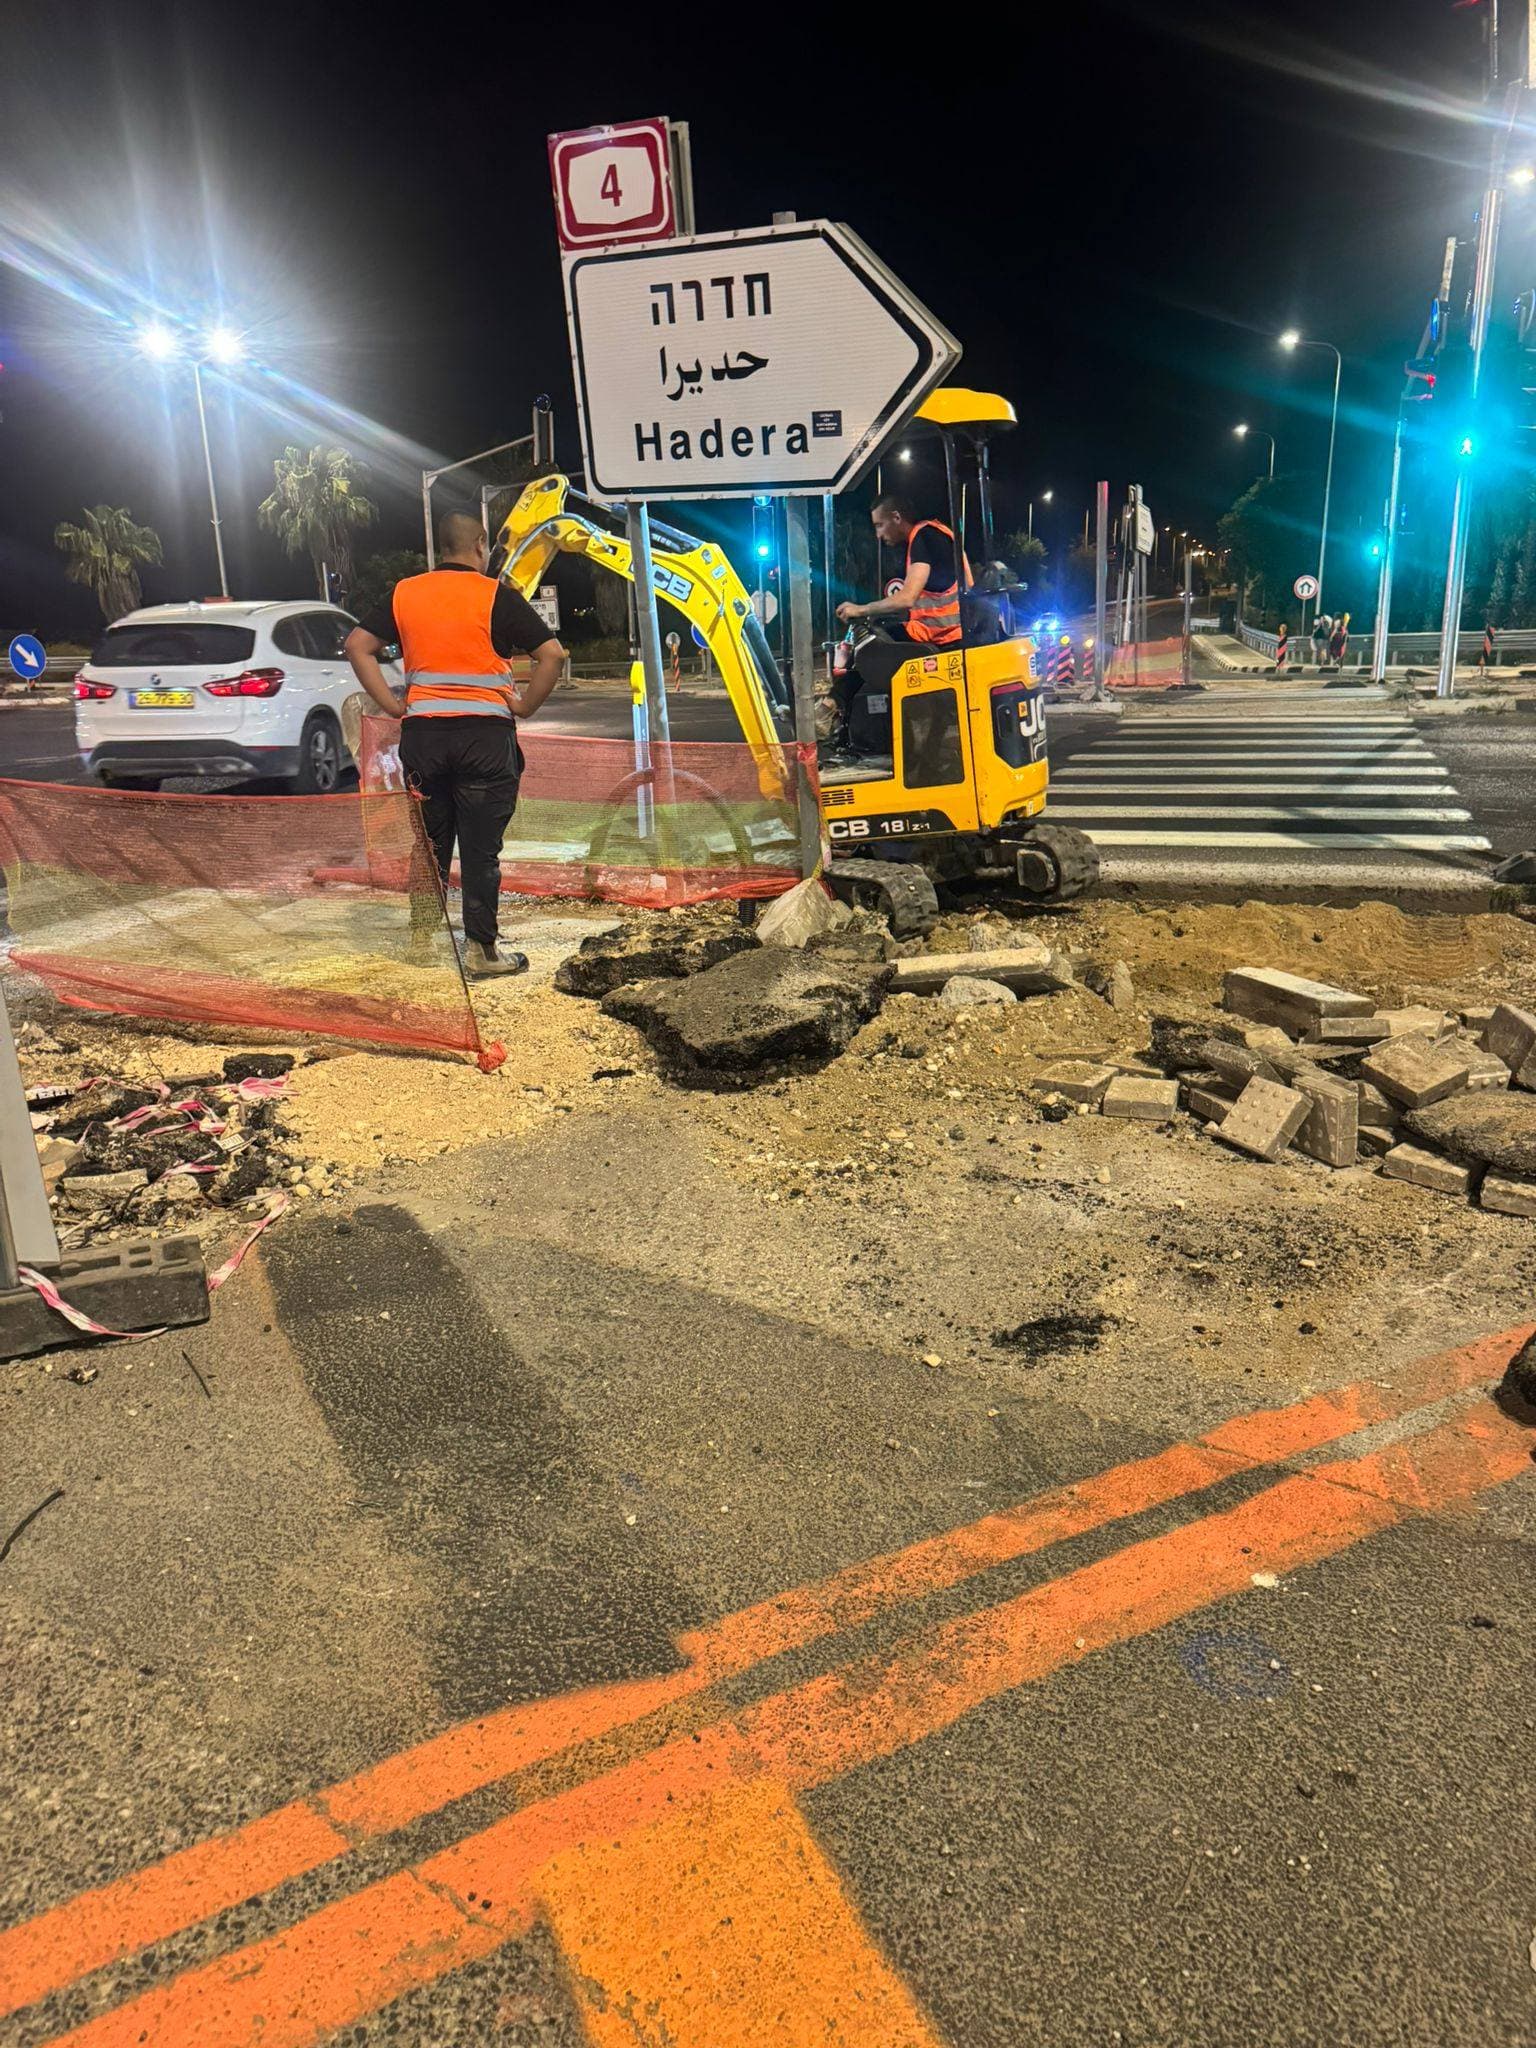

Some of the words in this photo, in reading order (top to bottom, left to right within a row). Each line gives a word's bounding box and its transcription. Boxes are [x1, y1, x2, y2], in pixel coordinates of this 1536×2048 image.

[599, 163, 623, 207] 4
[649, 272, 773, 326] חדרה
[658, 346, 770, 402] حديرا
[634, 418, 810, 462] Hadera
[828, 819, 871, 839] CB
[880, 820, 904, 834] 18
